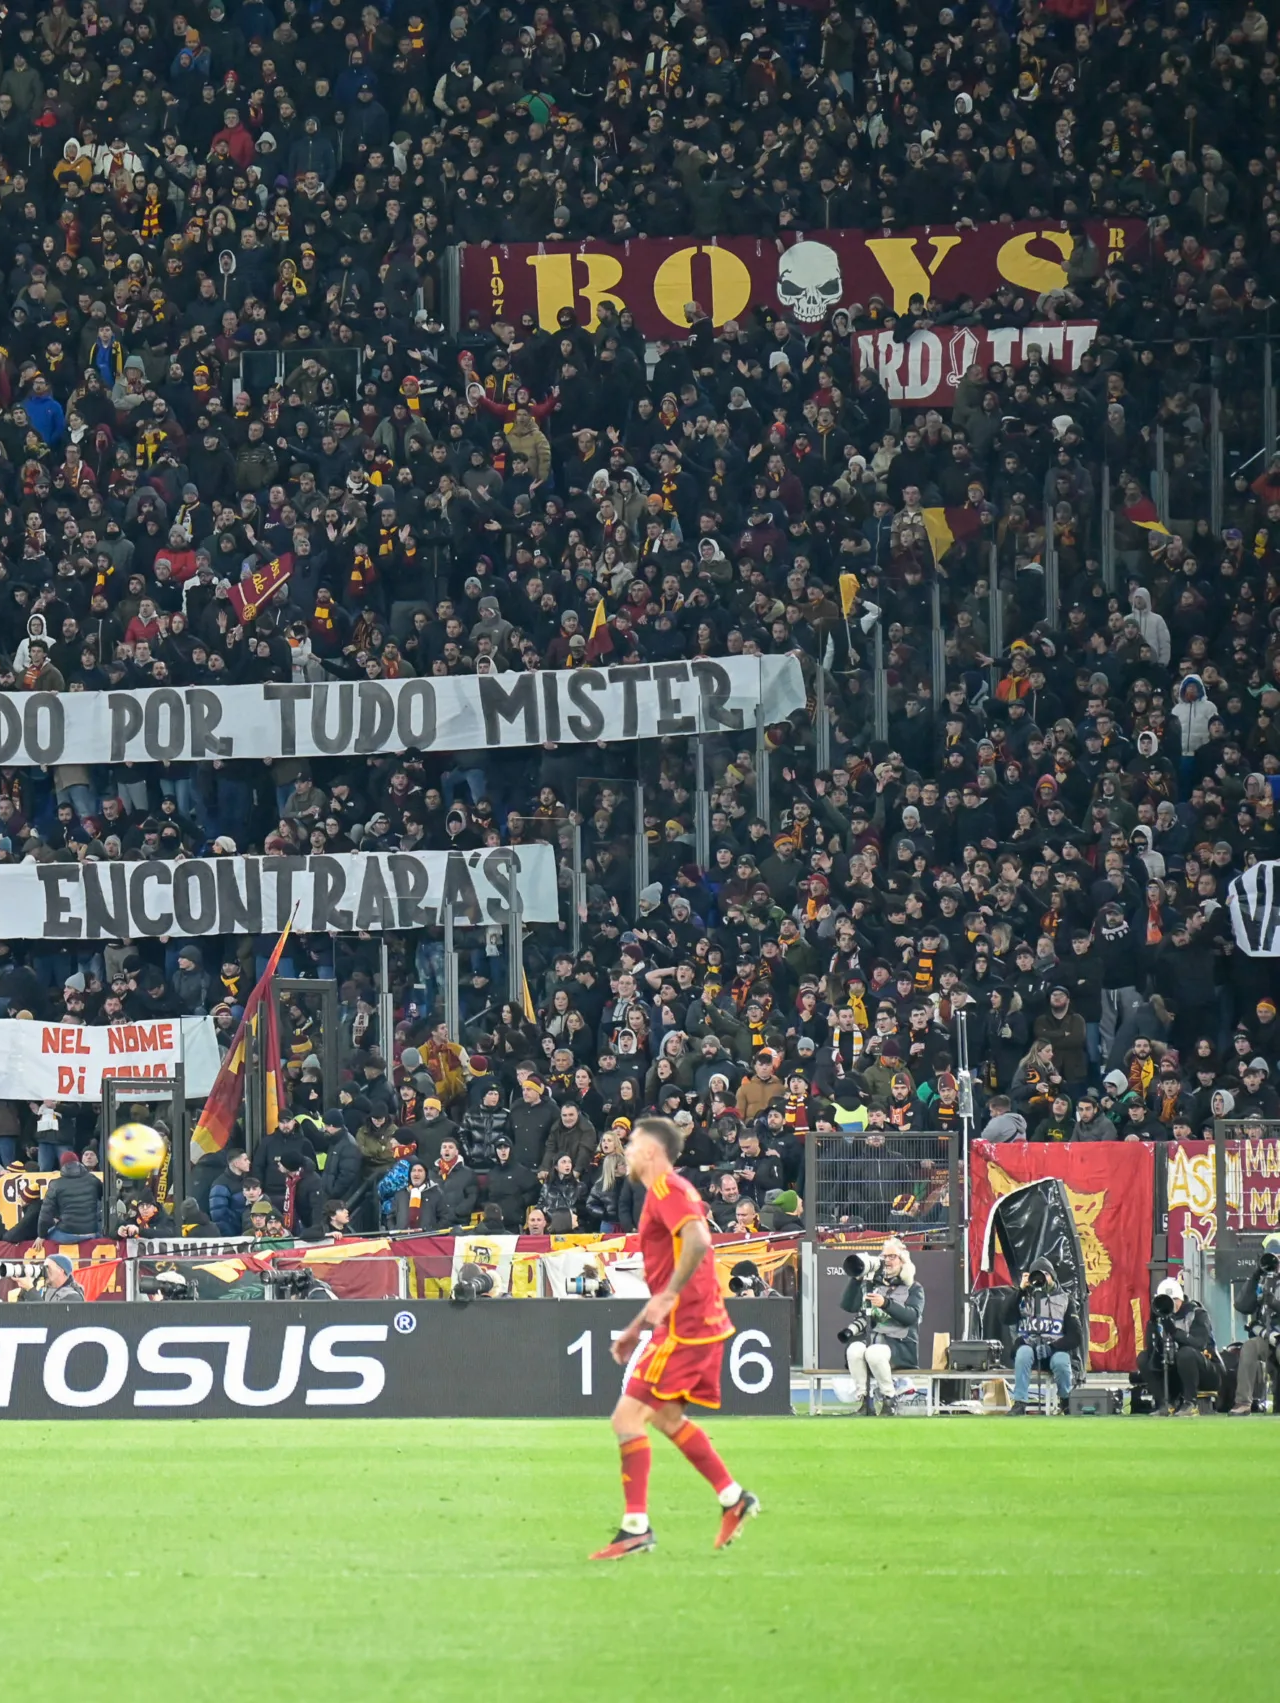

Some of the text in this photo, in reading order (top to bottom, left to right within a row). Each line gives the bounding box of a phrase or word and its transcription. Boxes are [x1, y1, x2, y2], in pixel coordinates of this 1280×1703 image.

[109, 687, 234, 762] POR
[263, 677, 438, 756] TUDO
[477, 662, 744, 746] MISTER
[41, 1023, 174, 1055] NEL NOME
